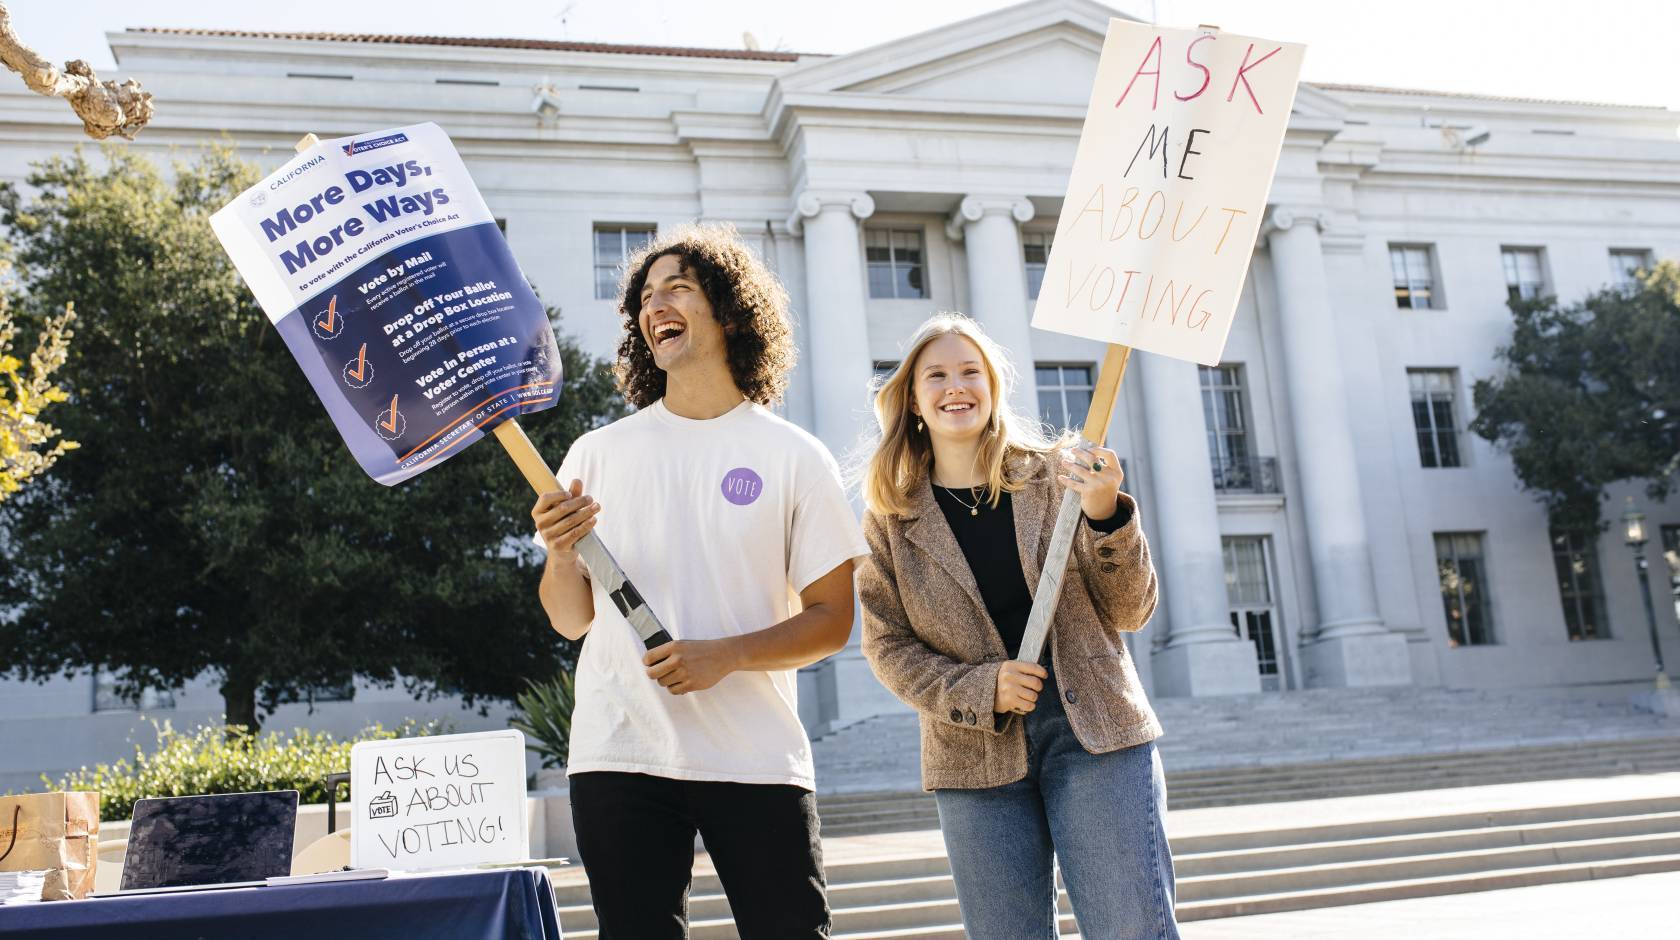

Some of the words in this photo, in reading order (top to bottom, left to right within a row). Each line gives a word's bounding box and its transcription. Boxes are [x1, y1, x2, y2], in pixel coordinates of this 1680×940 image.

[1115, 35, 1282, 115] ASK
[270, 155, 326, 190] CALIFORNIA
[1123, 123, 1211, 180] ME
[260, 186, 345, 242] More
[345, 160, 432, 193] Days,
[1064, 183, 1247, 254] ABOUT
[279, 217, 364, 275] More
[362, 188, 450, 223] Ways
[299, 283, 309, 291] to
[309, 273, 326, 287] vote
[327, 260, 345, 276] with
[344, 253, 358, 263] the
[357, 233, 395, 255] California
[395, 223, 423, 236] Voter's
[422, 217, 447, 227] Choice
[447, 213, 460, 221] Act
[357, 274, 388, 295] Vote
[386, 264, 405, 278] by
[404, 251, 433, 269] Mail
[366, 293, 381, 305] Every
[381, 284, 397, 296] active
[396, 270, 424, 287] registered
[424, 265, 438, 273] voter
[370, 297, 389, 311] receive
[393, 285, 409, 297] ballot
[424, 272, 436, 281] mail
[1065, 258, 1214, 332] VOTING
[383, 313, 414, 335] Drop
[413, 298, 436, 316] Off
[434, 289, 464, 305] Your
[463, 280, 497, 295] Ballot
[391, 334, 406, 348] at
[404, 330, 414, 339] a
[413, 312, 444, 333] Drop
[443, 302, 469, 316] Box
[467, 291, 513, 308] Location
[398, 346, 413, 358] Drop
[413, 340, 421, 349] off
[420, 335, 433, 345] your
[432, 325, 449, 337] ballot
[475, 310, 487, 319] drop
[402, 345, 430, 364] beginning
[436, 332, 450, 343] days
[449, 327, 463, 337] prior
[415, 367, 445, 388] Vote
[443, 358, 459, 371] in
[457, 341, 498, 362] Person
[497, 337, 511, 347] at
[509, 336, 518, 344] a
[422, 375, 457, 400] Voter
[457, 355, 497, 378] Center
[431, 394, 453, 410] Register
[471, 375, 485, 385] drop
[491, 367, 503, 376] your
[441, 399, 460, 414] person
[459, 389, 475, 401] within
[474, 383, 485, 392] any
[400, 443, 439, 471] CALIFORNIA
[439, 417, 476, 446] SECRETARY
[475, 410, 487, 420] OF
[486, 397, 508, 413] STATE
[728, 477, 757, 497] VOTE
[374, 755, 435, 785] ASK
[444, 754, 479, 777] US
[371, 805, 392, 816] VOTE
[406, 782, 495, 816] ABOUT
[378, 816, 506, 858] VOTING!
